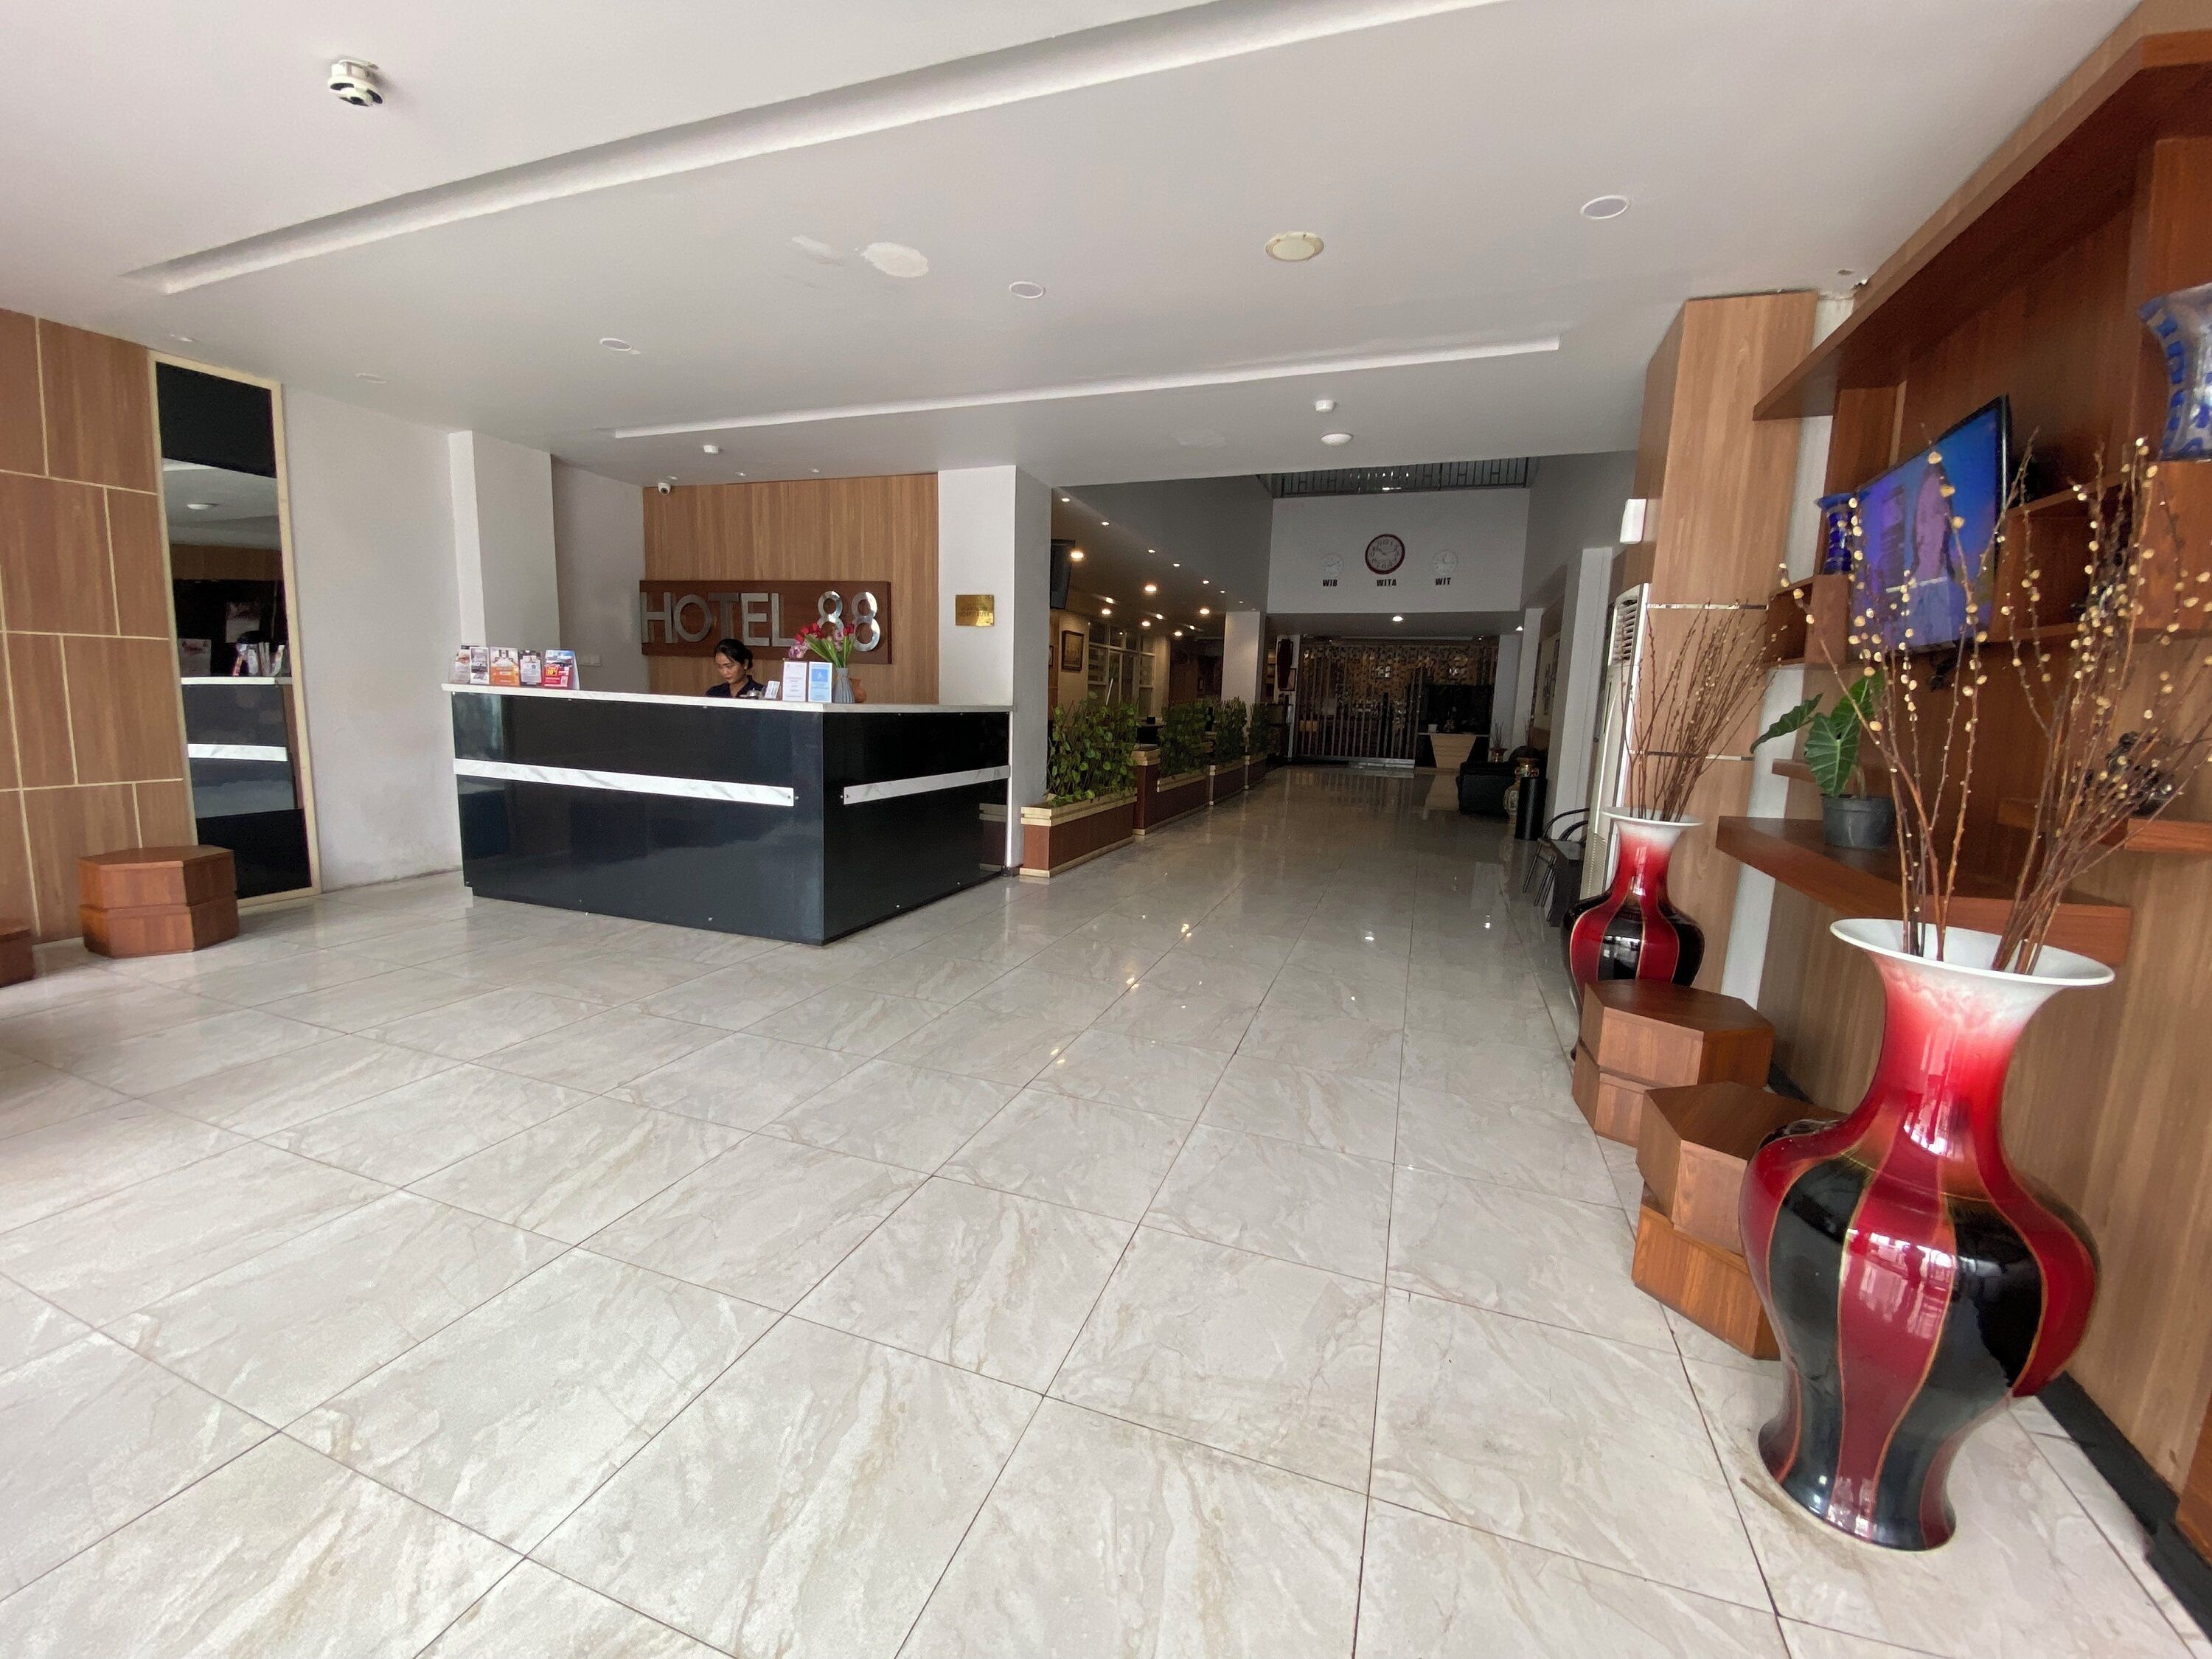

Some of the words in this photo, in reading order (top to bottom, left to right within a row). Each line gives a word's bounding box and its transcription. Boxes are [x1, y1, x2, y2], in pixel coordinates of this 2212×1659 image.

[1377, 579, 1397, 587] WITA
[1436, 577, 1451, 585] WIT
[641, 592, 796, 647] HOTEL
[817, 591, 880, 652] 88
